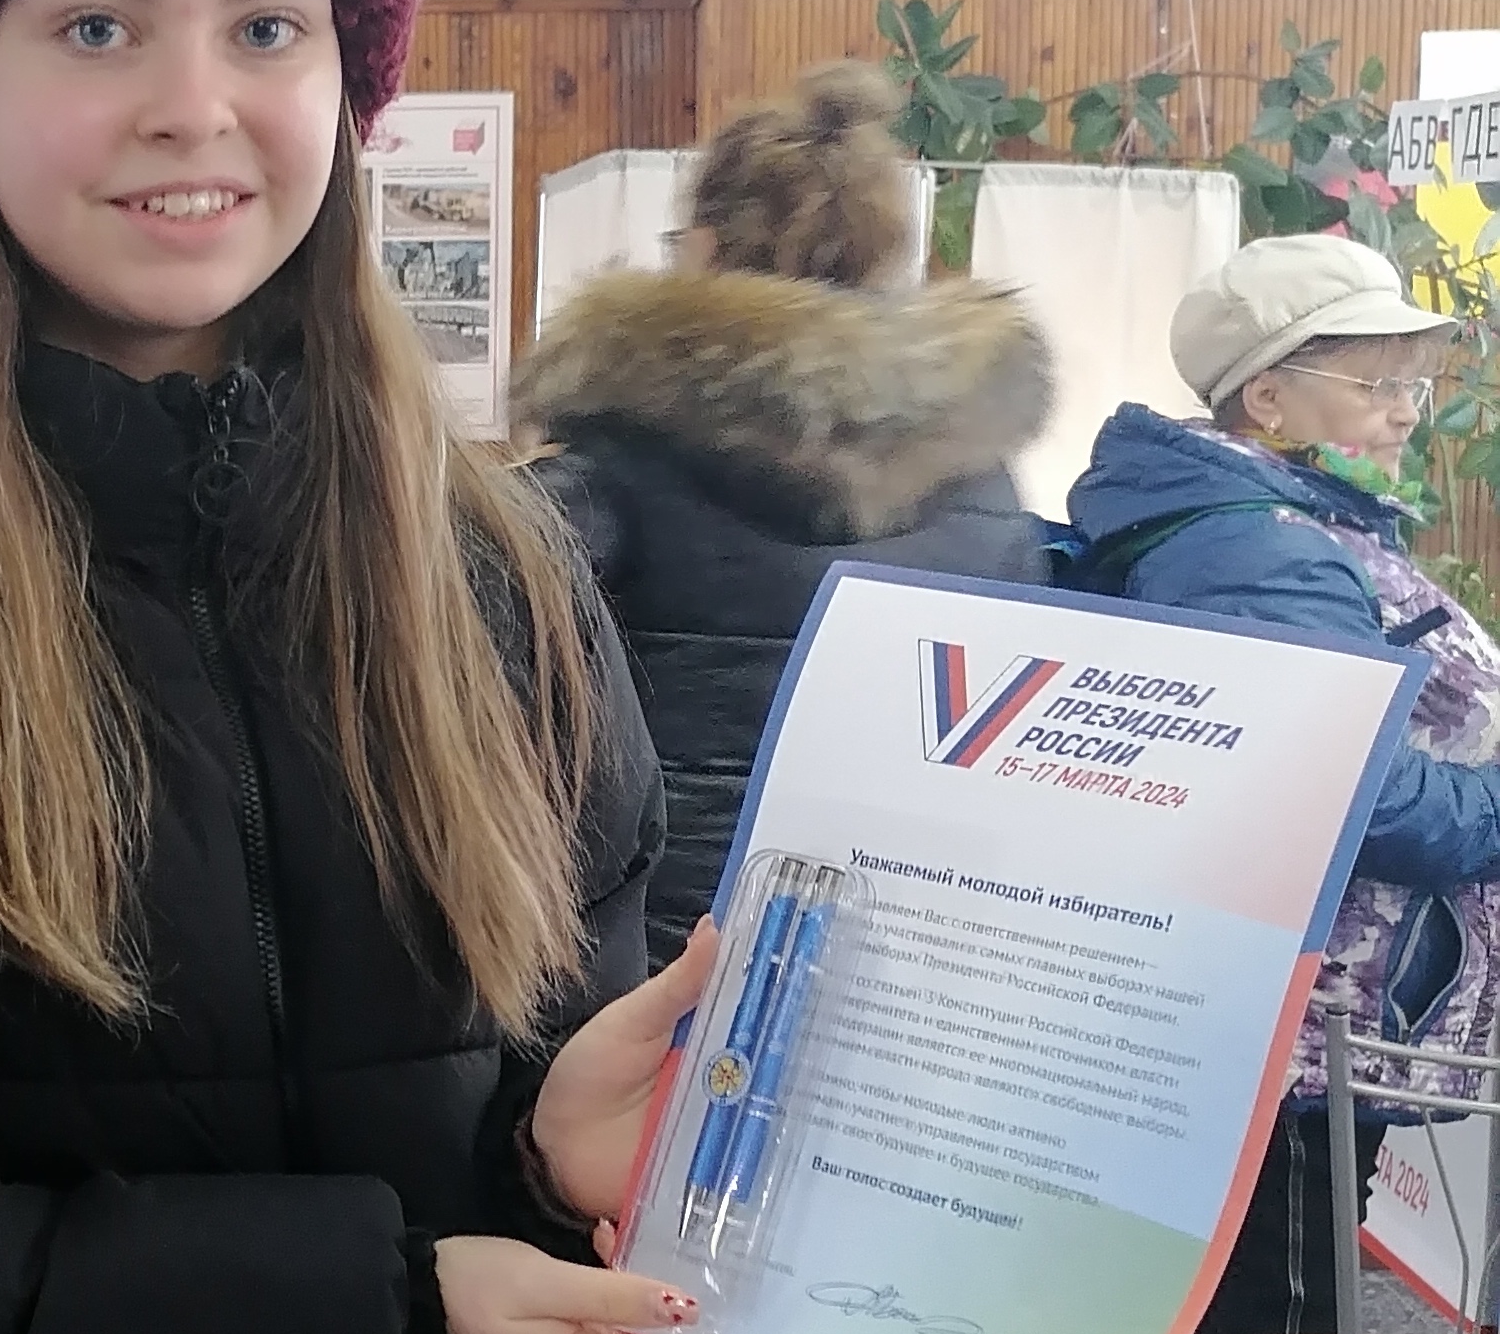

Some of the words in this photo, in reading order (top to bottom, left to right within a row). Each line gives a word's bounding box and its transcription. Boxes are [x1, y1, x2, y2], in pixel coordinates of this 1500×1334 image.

[1388, 115, 1438, 171] АБВ
[1070, 666, 1216, 709] ВЫБОРЫ
[1015, 726, 1147, 768] РОССИИ
[1042, 696, 1244, 750] ПРЕЗИДЕНТА
[1053, 765, 1133, 799] МАРТА
[1130, 781, 1190, 809] 2024
[850, 847, 954, 886] Уважаемый
[957, 874, 1044, 905] молодой
[1049, 895, 1174, 933] избиратель!
[924, 908, 948, 927] Вас
[951, 917, 959, 928] с
[962, 919, 1066, 953] ответственным
[1069, 943, 1146, 970] решением
[922, 953, 1002, 985] Президента
[1006, 972, 1089, 1006] Российской
[979, 944, 1026, 966] самых
[1026, 958, 1085, 981] главных
[1088, 970, 1153, 995] выборах
[1155, 986, 1206, 1007] нашей
[936, 1017, 1037, 1052] единственным
[1039, 1043, 1126, 1076] источником
[1130, 1067, 1180, 1090] власти
[937, 991, 1024, 1027] Конституции
[1028, 1015, 1111, 1049] Российской
[1115, 1037, 1202, 1071] Федерации
[989, 1053, 1139, 1104] многонациональный
[903, 1094, 967, 1122] молодые
[967, 1113, 1005, 1132] люди
[1042, 1092, 1125, 1125] свободные
[811, 1155, 842, 1178] Ваш
[845, 1167, 888, 1191] голос
[889, 1180, 950, 1211] создает
[1394, 1158, 1430, 1218] 2024
